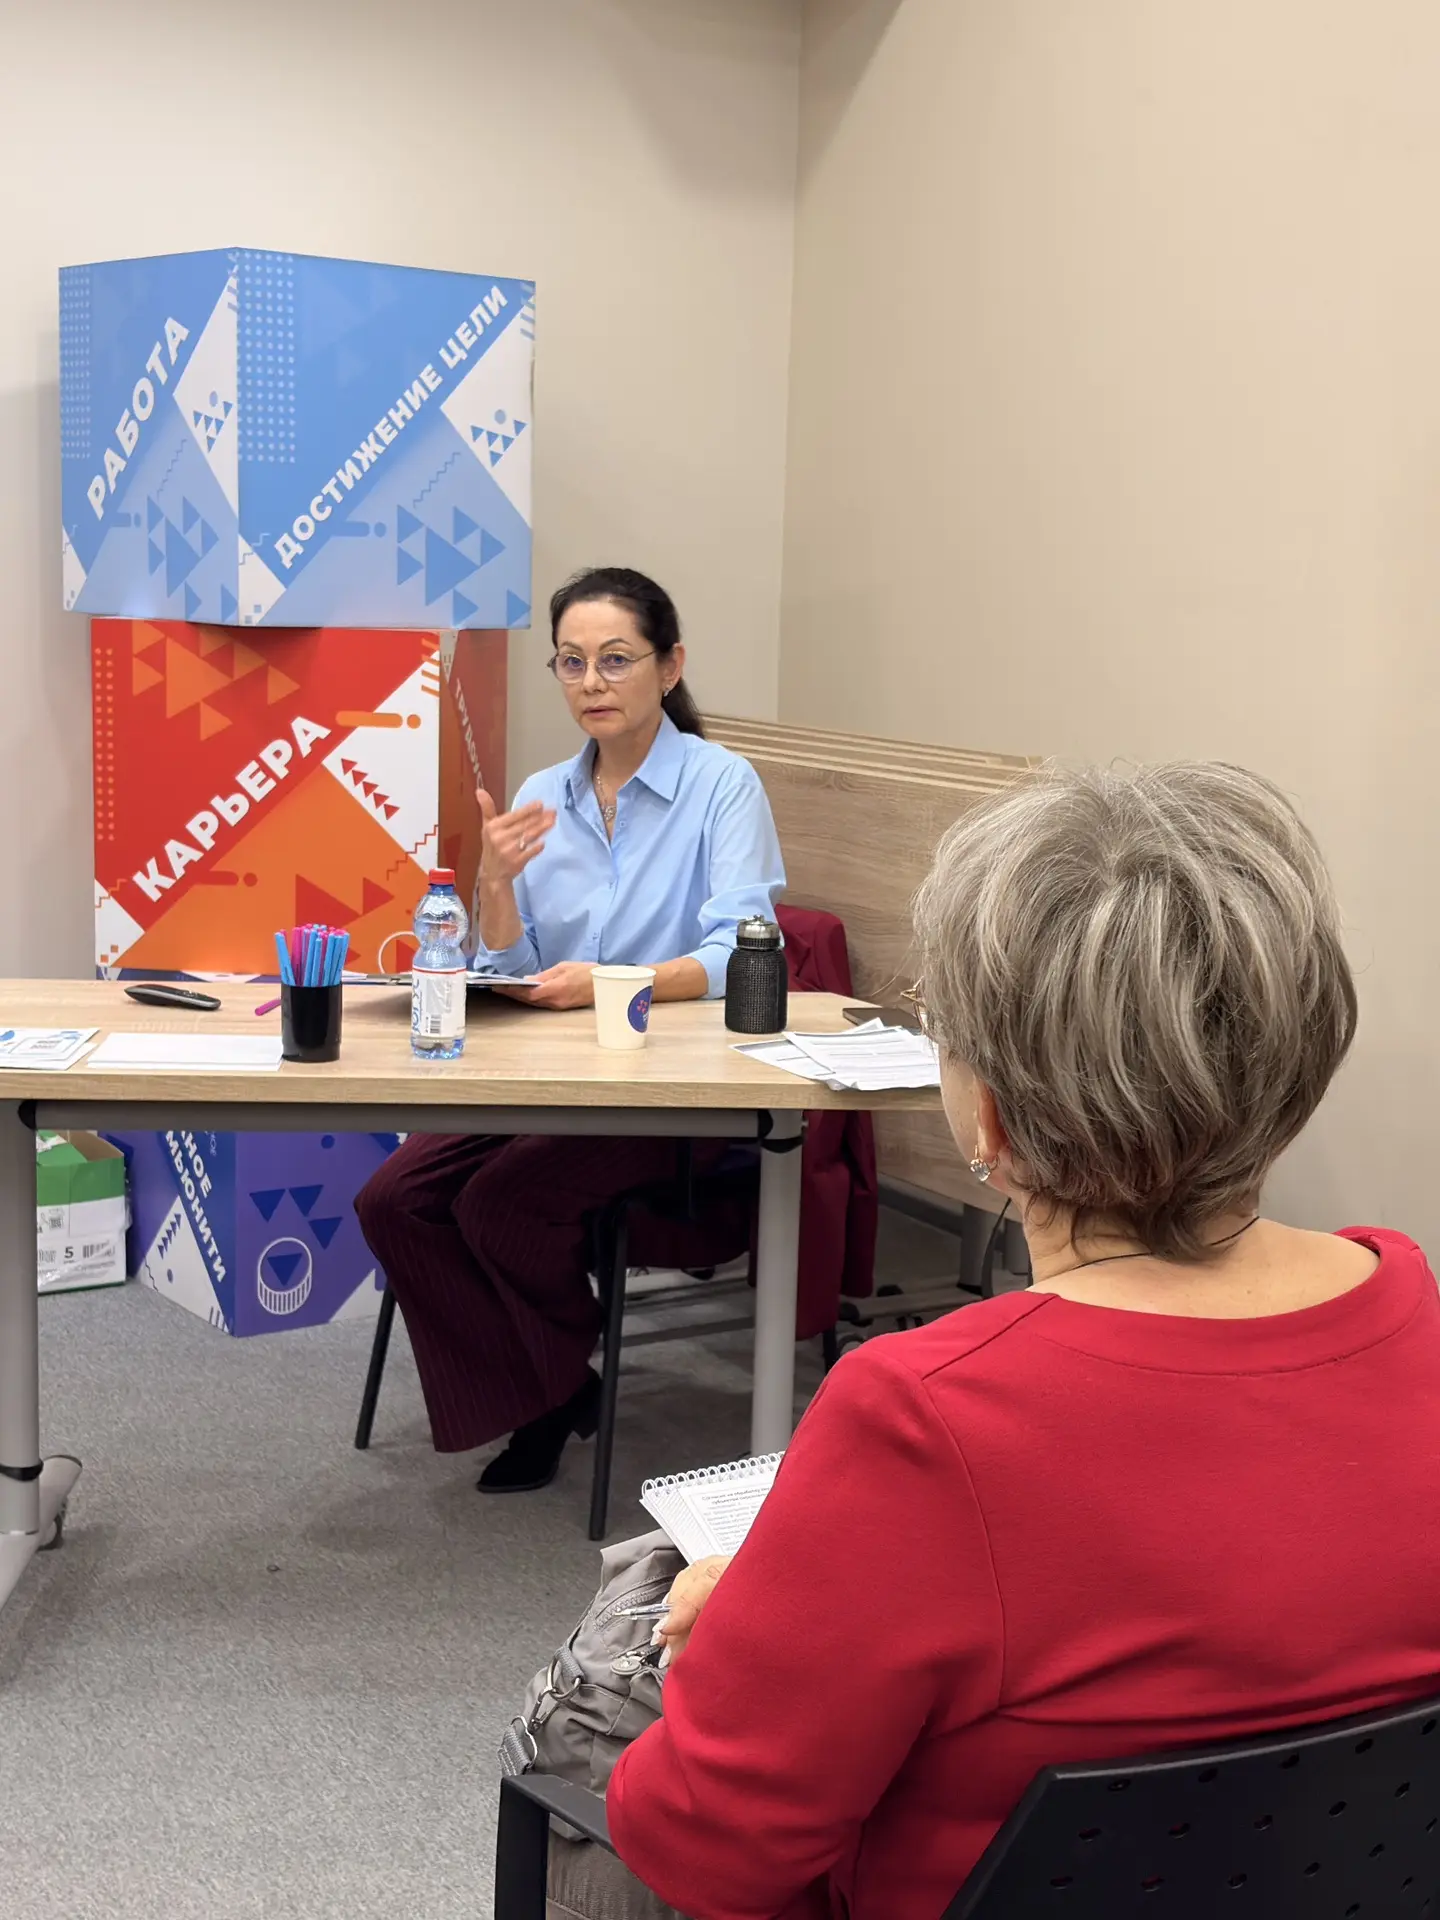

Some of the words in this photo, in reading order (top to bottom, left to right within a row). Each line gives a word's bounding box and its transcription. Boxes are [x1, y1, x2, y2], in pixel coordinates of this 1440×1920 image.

[86, 316, 190, 521] РАБОТА
[273, 363, 443, 569] ДОСТИЖЕНИЕ
[438, 285, 508, 371] ЦЕЛИ
[132, 715, 332, 902] КАРЬЕРА
[64, 1246, 74, 1259] 5
